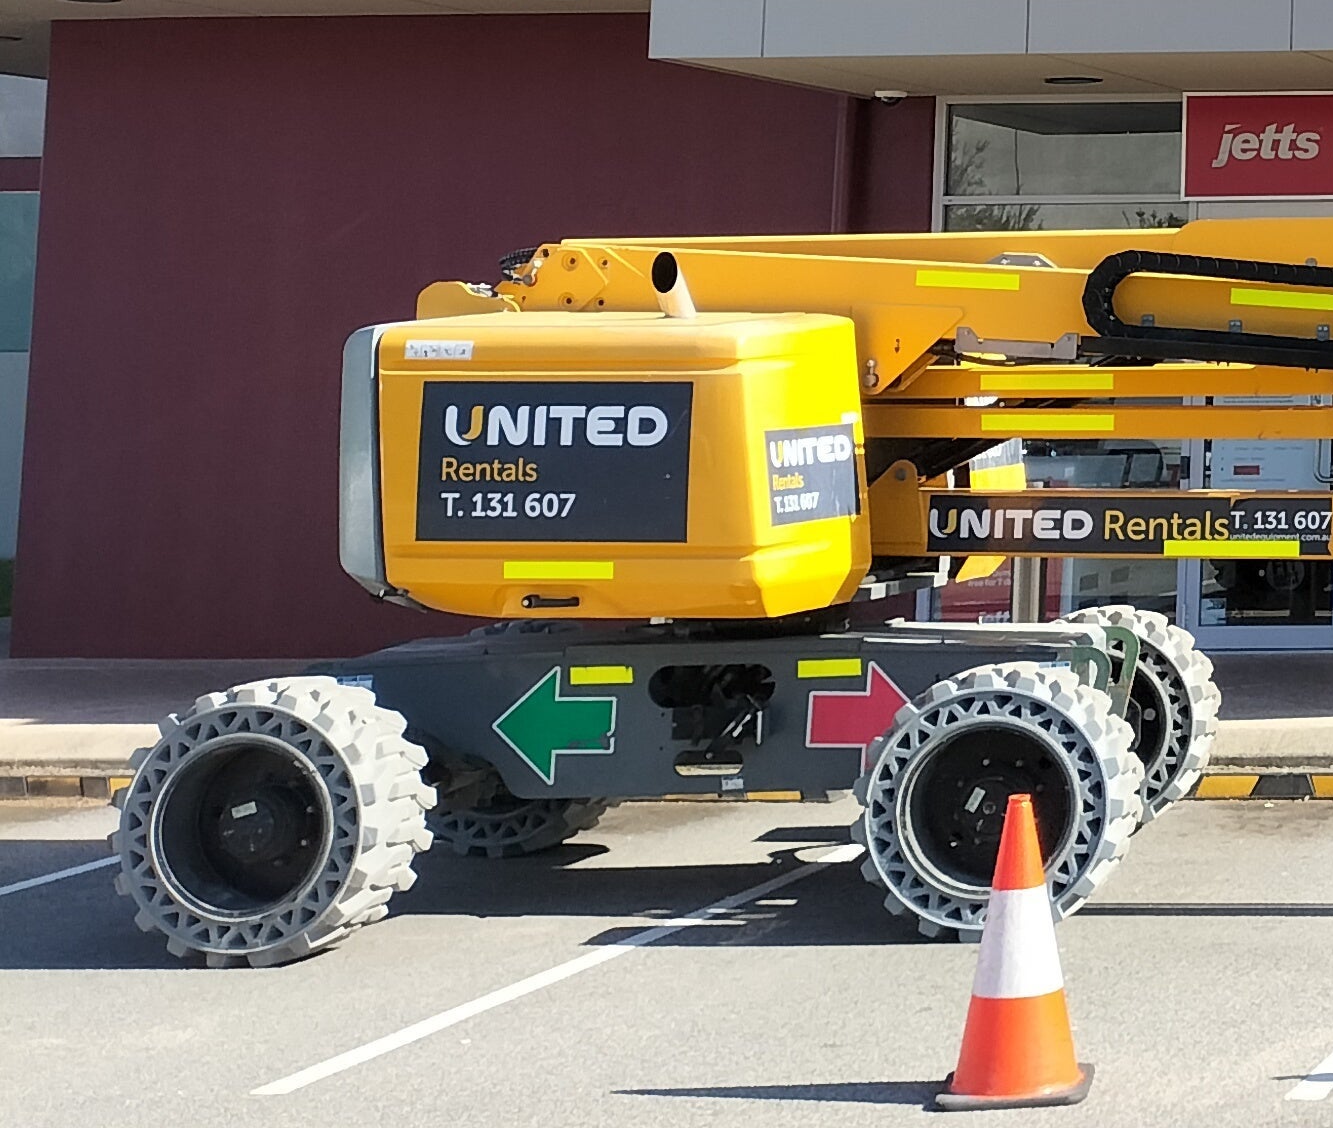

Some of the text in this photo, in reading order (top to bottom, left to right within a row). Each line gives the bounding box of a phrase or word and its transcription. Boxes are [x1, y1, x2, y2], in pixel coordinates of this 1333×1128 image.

[1211, 123, 1321, 168] jetts
[444, 405, 668, 446] UNITED
[769, 434, 852, 468] UNITED
[441, 458, 537, 482] Rentals
[772, 472, 804, 490] Rentals
[440, 492, 576, 517] T. 131 607
[784, 494, 800, 512] 131
[800, 491, 820, 510] 607
[929, 508, 1333, 541] UNITED Rentals T. 131 607
